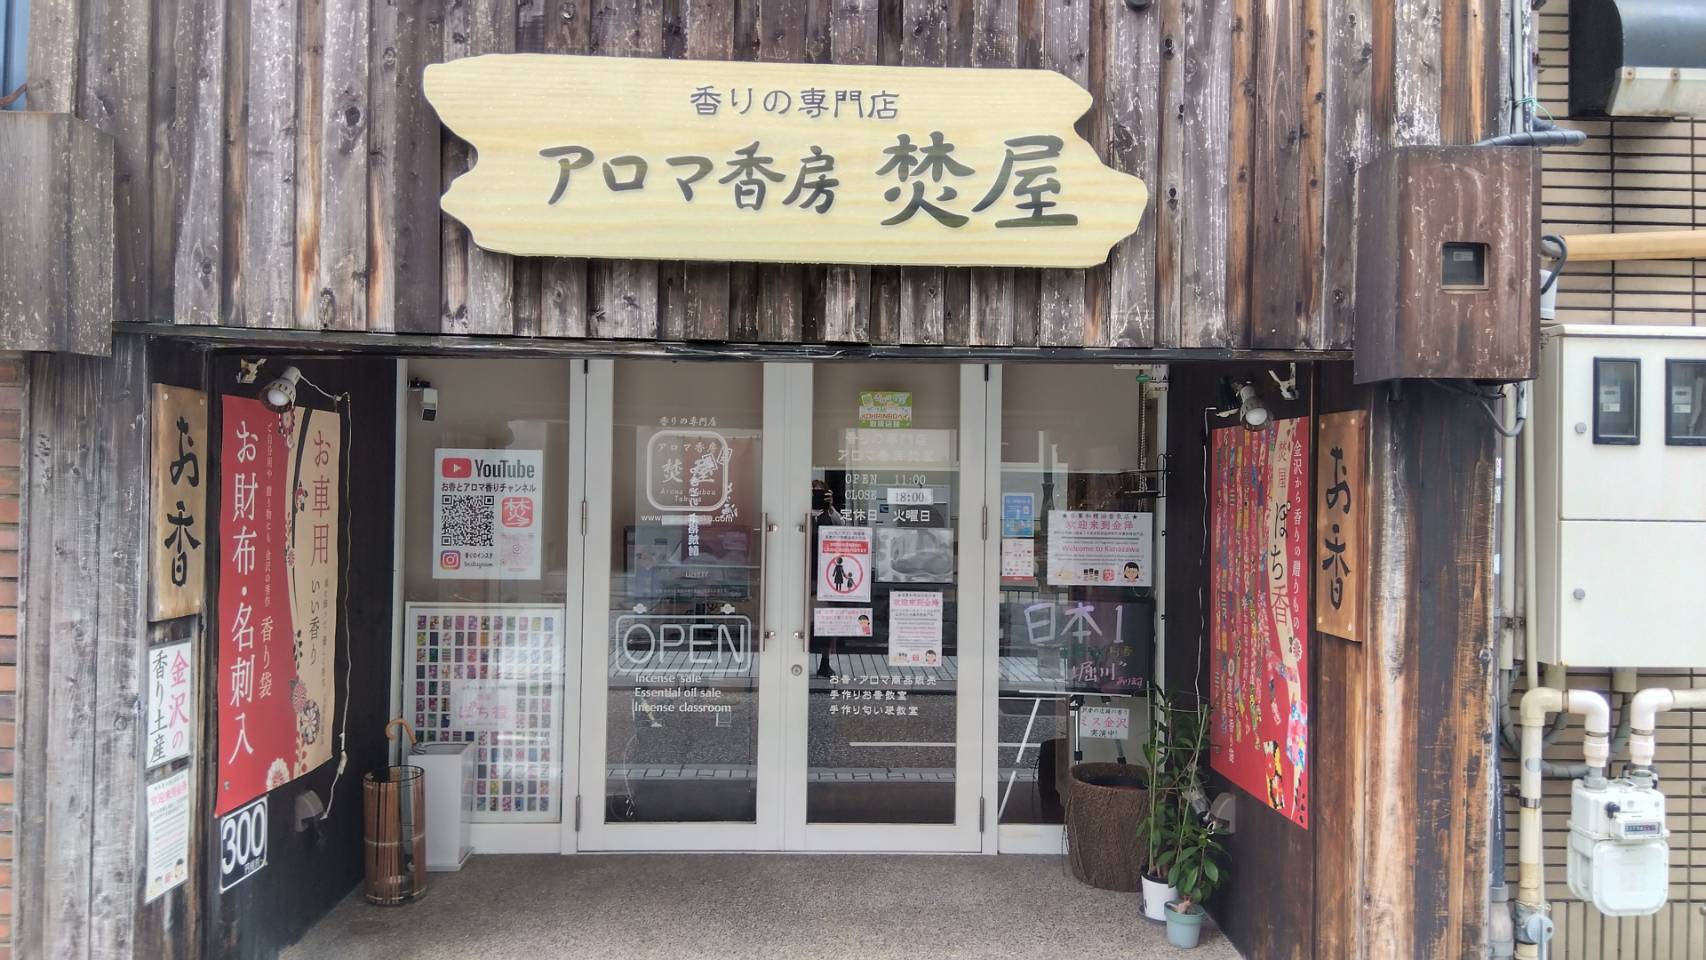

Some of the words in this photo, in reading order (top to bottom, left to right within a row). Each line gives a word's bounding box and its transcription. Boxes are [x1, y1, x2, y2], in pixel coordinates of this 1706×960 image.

[690, 86, 901, 120] 香りの専門店
[539, 141, 841, 213] アロマ香房
[875, 131, 1079, 229] 焚屋
[474, 459, 535, 478] YouTube
[845, 474, 877, 485] OPEN
[895, 475, 926, 485] 11:00
[845, 490, 877, 500] CLOSE
[895, 493, 925, 502] 18:00
[164, 416, 201, 587] お香
[311, 430, 331, 567] お車用
[840, 509, 877, 521] 定休日
[892, 509, 930, 522] 火曜日
[1322, 446, 1352, 609] お香
[229, 421, 259, 764] お財布・名刺入
[258, 616, 273, 699] 香り袋
[623, 624, 744, 664] OPEN
[150, 650, 168, 763] 香り土産
[168, 650, 189, 750] 金沢の
[634, 687, 681, 698] Essential
[684, 687, 697, 697] oil
[700, 687, 722, 697] sale
[635, 674, 675, 683] Incense
[680, 674, 701, 683] sale
[634, 702, 675, 712] Incense
[679, 702, 731, 712] classroom
[222, 803, 266, 875] 300
